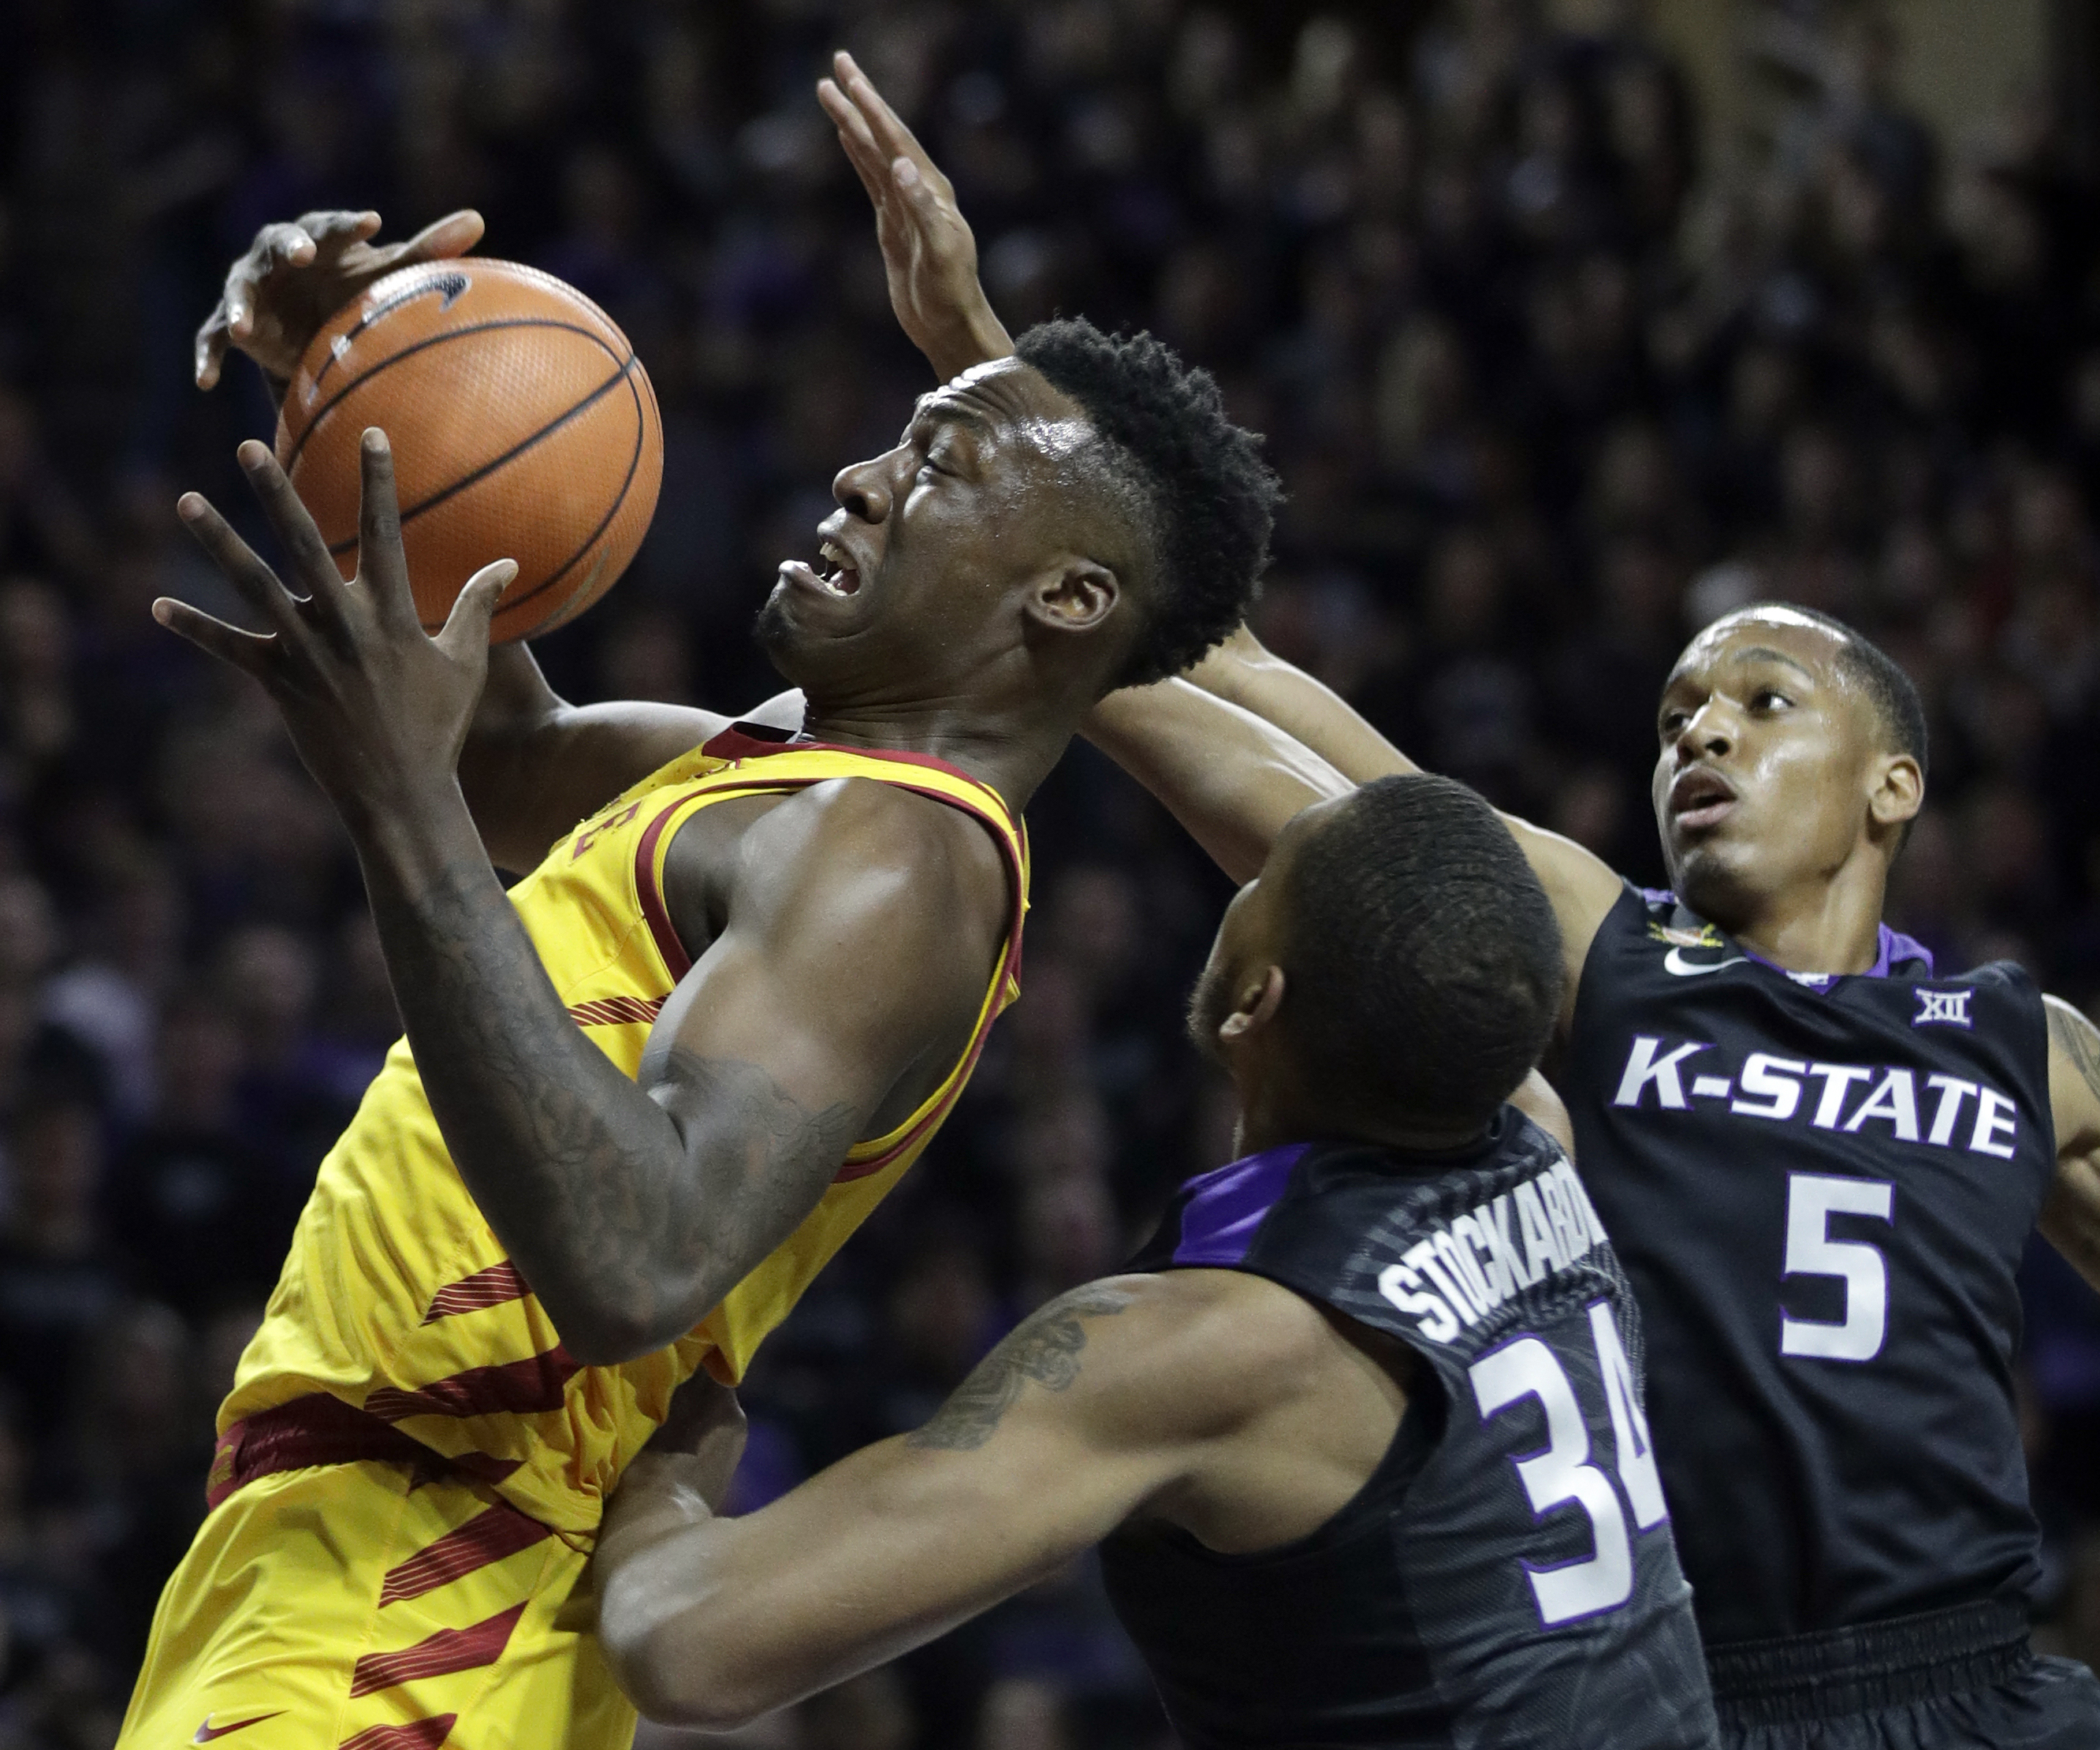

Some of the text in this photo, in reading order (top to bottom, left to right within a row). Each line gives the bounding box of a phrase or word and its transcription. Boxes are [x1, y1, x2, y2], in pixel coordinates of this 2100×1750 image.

[1914, 987, 1974, 1026] XII
[1612, 1034, 2018, 1160] K-STATE
[1780, 1171, 1893, 1362] 5
[1467, 1298, 1670, 1630] 34
